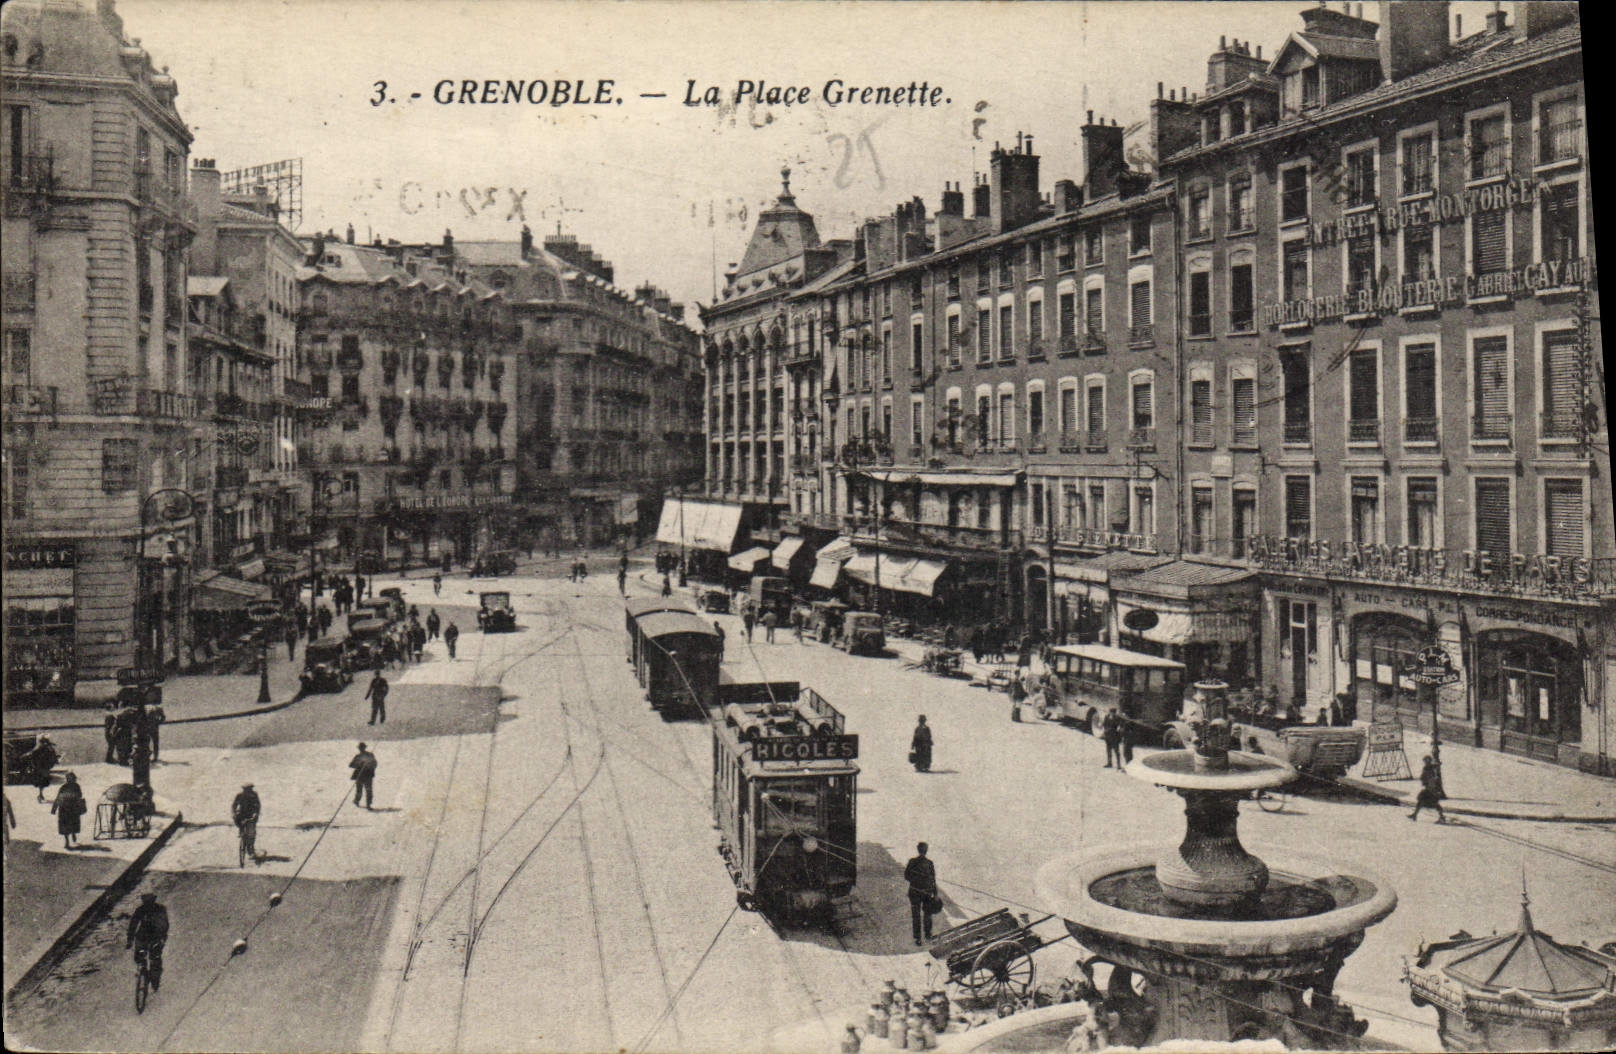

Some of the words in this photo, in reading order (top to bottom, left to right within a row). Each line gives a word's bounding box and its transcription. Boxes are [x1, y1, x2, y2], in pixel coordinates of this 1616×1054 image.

[1387, 202, 1421, 230] RUE
[1428, 178, 1532, 222] MONTORGE
[1264, 294, 1350, 325] HORLOGERIE
[1358, 276, 1457, 313] BIJOUTERIE
[1355, 592, 1380, 605] AUTO
